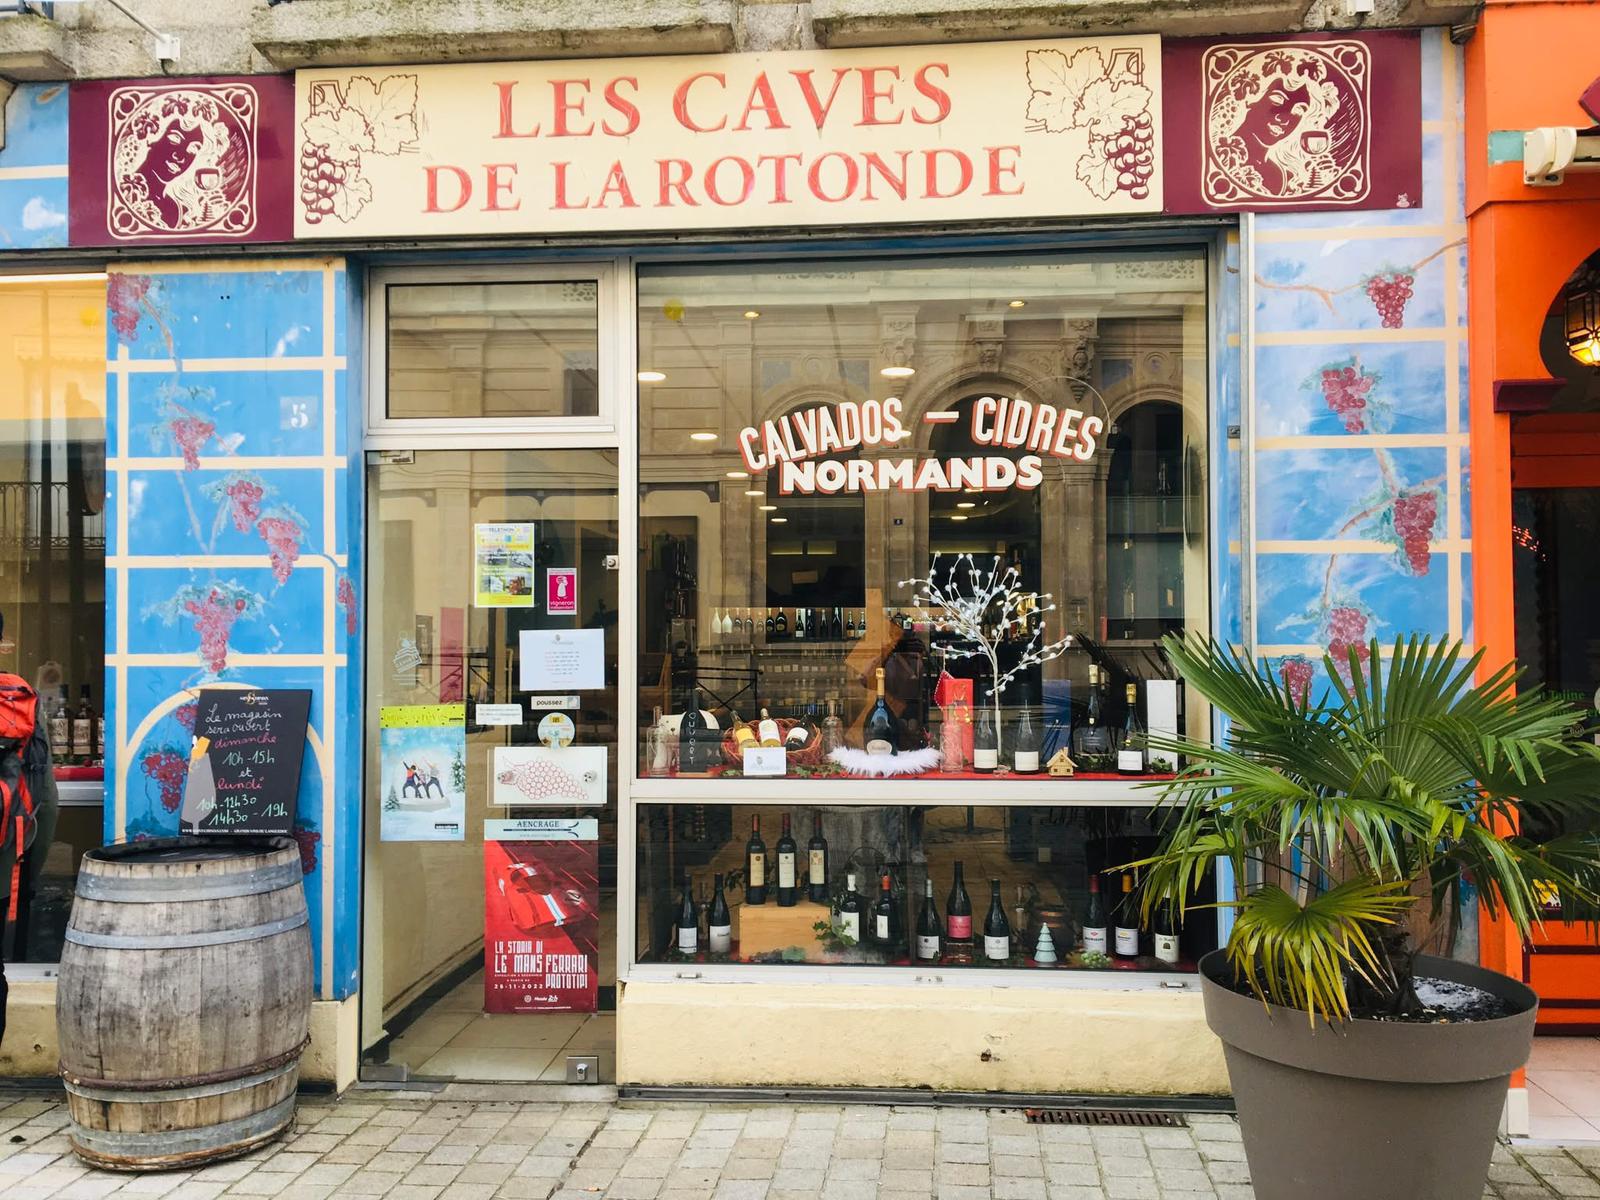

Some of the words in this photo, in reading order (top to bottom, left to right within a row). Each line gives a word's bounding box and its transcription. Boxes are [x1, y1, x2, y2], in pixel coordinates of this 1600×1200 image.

[492, 76, 640, 139] LES
[672, 62, 952, 133] CAVES
[421, 162, 522, 213] DE
[549, 159, 641, 209] LA
[653, 145, 1026, 207] ROTONDE
[736, 396, 903, 475] CALVADOS
[971, 396, 1103, 463] CIDRES
[778, 455, 1044, 495] NORMANDS
[205, 703, 222, 723] Le
[225, 708, 282, 721] magasin
[205, 726, 230, 734] sera
[232, 720, 271, 733] ouvert
[214, 732, 277, 749] dimanche
[238, 767, 254, 778] et
[216, 776, 265, 790] lundi
[208, 809, 248, 826] 14h30
[260, 803, 288, 817] 19h
[516, 820, 560, 828] AENCRAGE
[494, 941, 504, 954] LA
[507, 941, 532, 954] STORIA
[536, 941, 543, 954] DI
[494, 954, 507, 973] LE
[514, 954, 543, 973] MANS
[545, 954, 588, 973] FERRARI
[545, 973, 588, 989] PROTOTIPI
